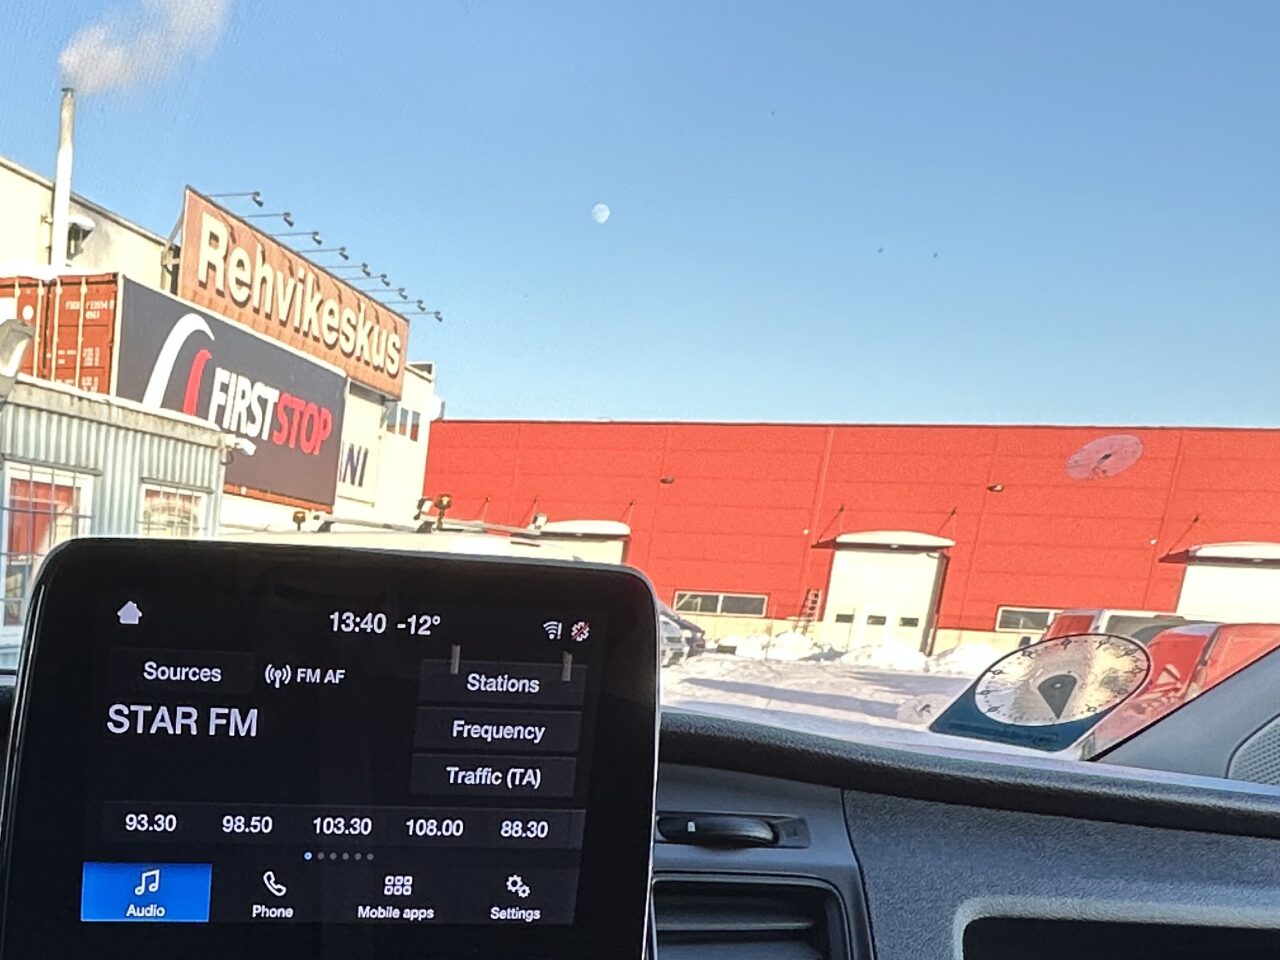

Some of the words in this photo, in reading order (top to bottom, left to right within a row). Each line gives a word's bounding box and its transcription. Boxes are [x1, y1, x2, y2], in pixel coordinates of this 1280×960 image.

[198, 212, 401, 376] Rehvikeskus
[330, 612, 387, 634] 13:40
[397, 614, 441, 636] -12°
[143, 662, 222, 682] Sources
[297, 669, 320, 684] FM
[323, 669, 346, 684] AF
[466, 673, 540, 693] Stations
[106, 703, 198, 736] STAR
[209, 707, 258, 737] FM
[452, 720, 546, 744] Frequency
[446, 766, 503, 786] Traffic
[506, 767, 541, 790] (TA)
[125, 813, 177, 832] 93.30
[222, 815, 273, 834] 98.50
[313, 817, 372, 836] 103.30
[406, 818, 464, 837] 108.00
[500, 820, 549, 838] 88.30
[126, 904, 166, 918] Audio
[252, 904, 294, 918] Phone
[357, 905, 401, 919] Mobile
[403, 908, 435, 922] apps
[490, 906, 541, 923] Settings
